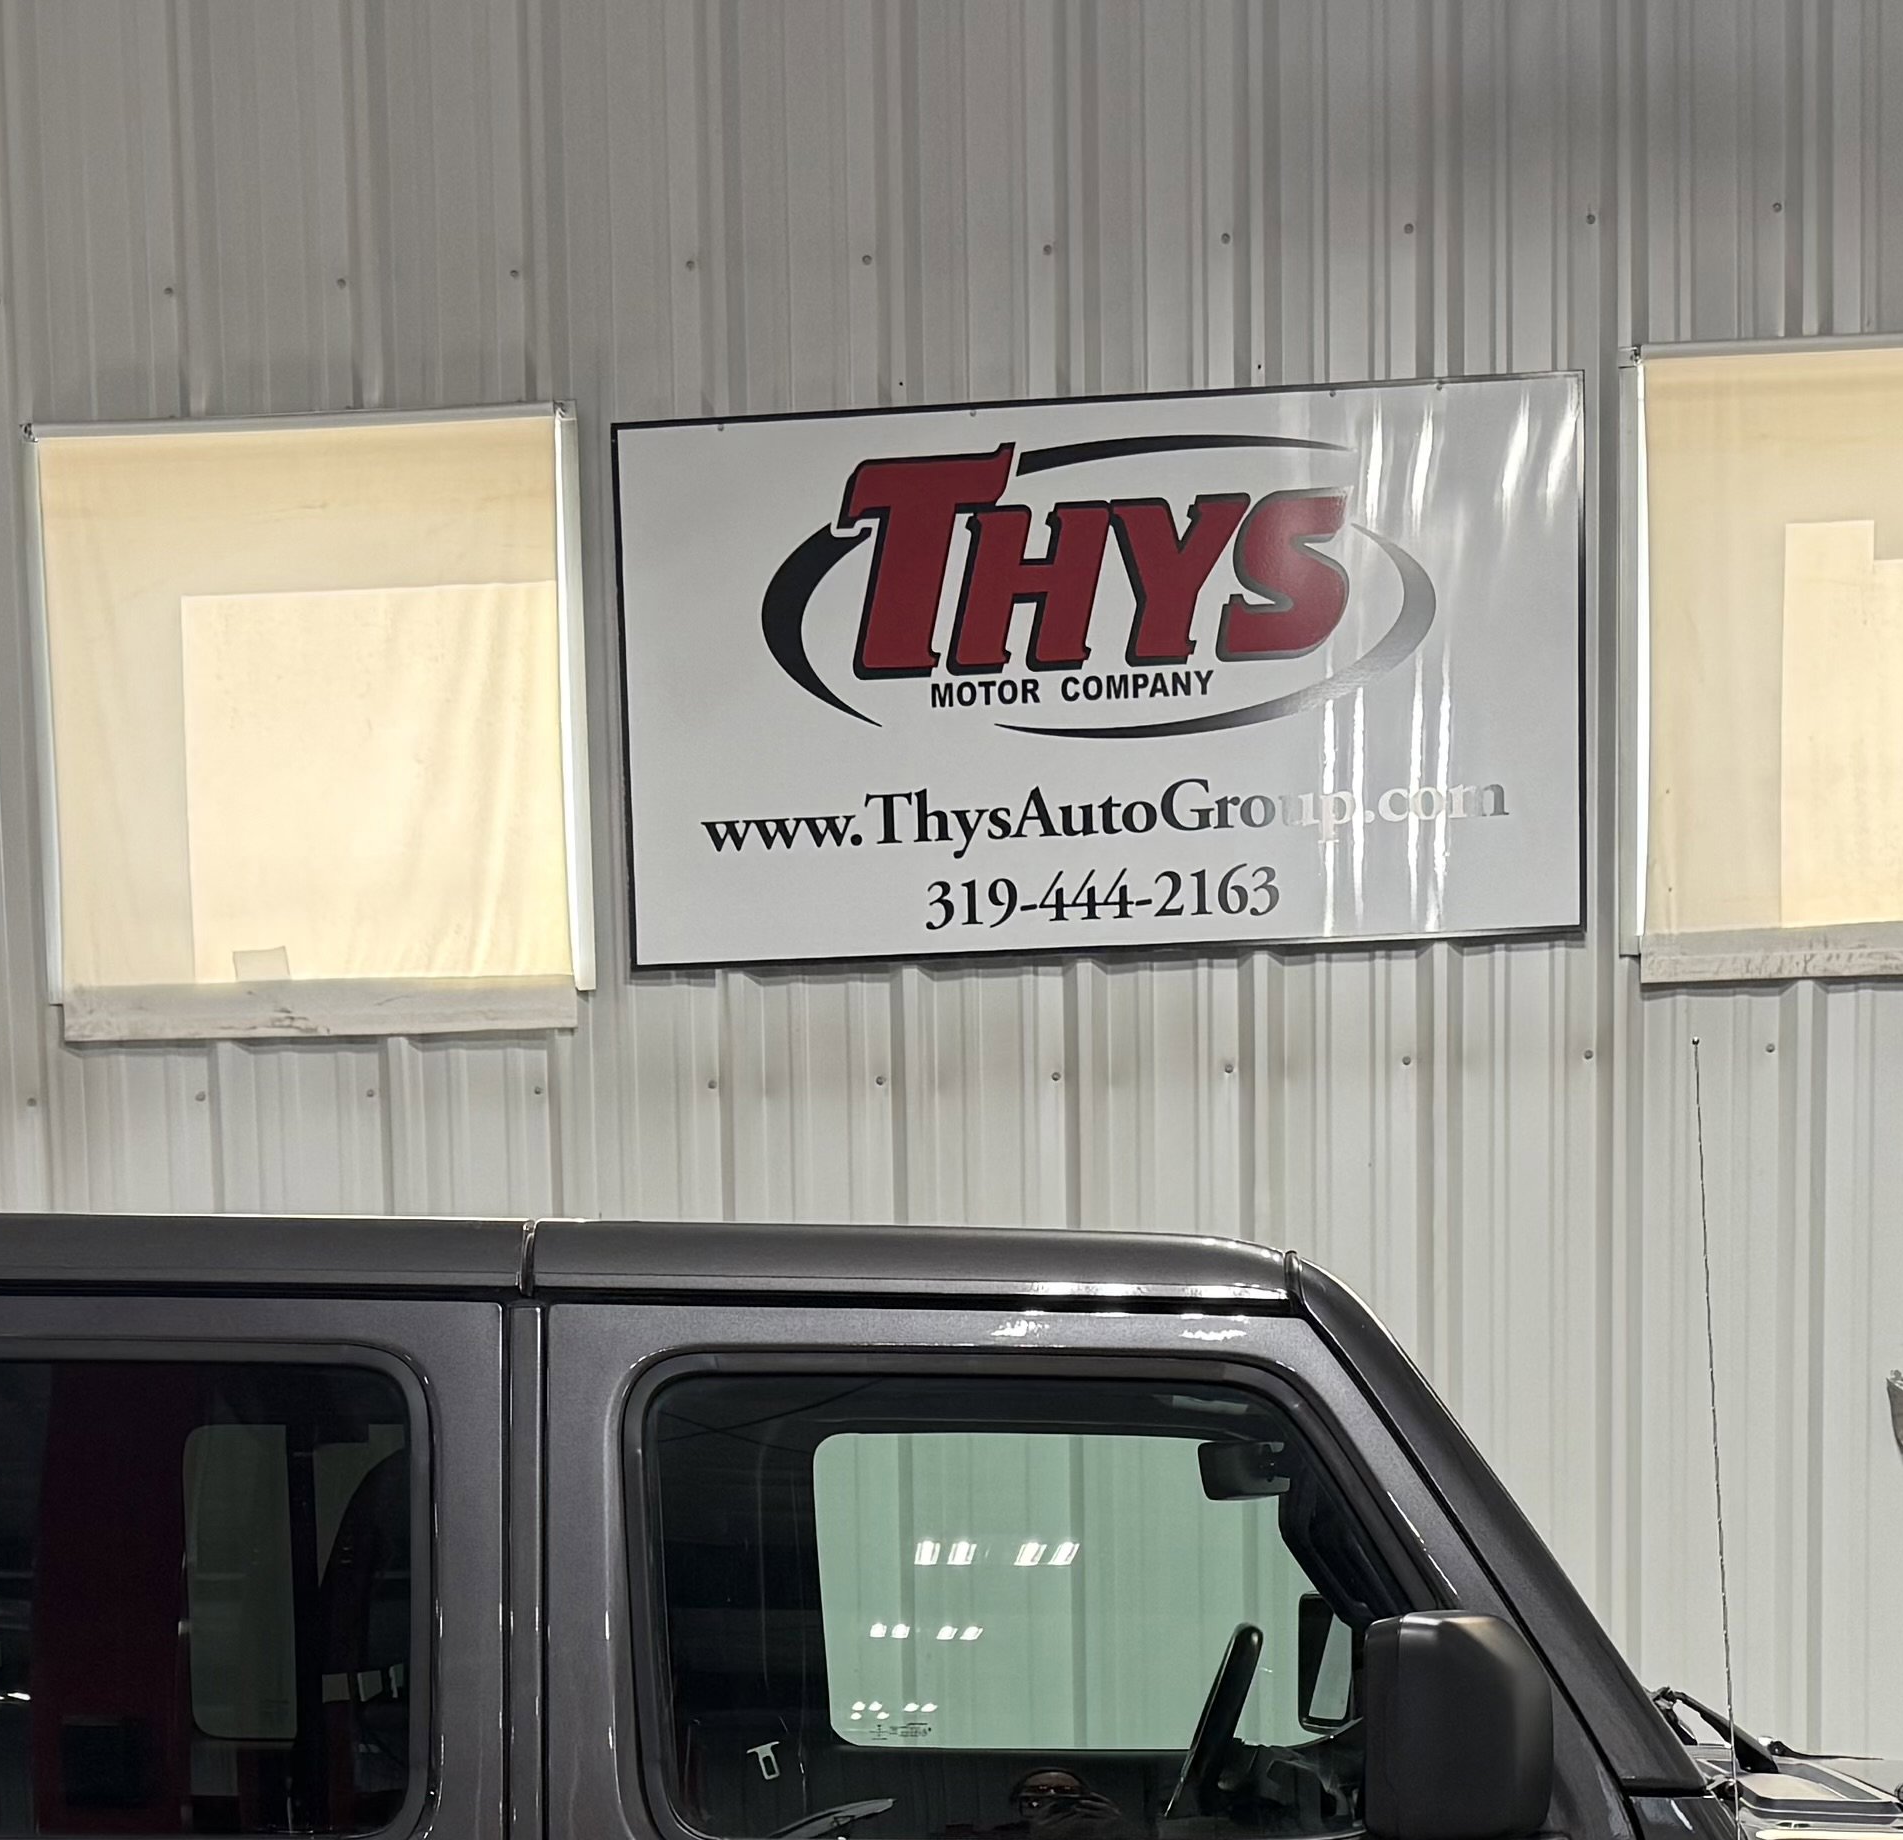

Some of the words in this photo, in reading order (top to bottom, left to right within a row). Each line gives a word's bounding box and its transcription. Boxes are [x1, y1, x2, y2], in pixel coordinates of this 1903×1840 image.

[831, 441, 1353, 680] THYS
[930, 678, 1041, 708] MOTOR
[1060, 669, 1214, 702] COMPANY
[700, 778, 1509, 858] www.ThysAutoGroup.com
[925, 865, 1280, 930] 319-444-2163
